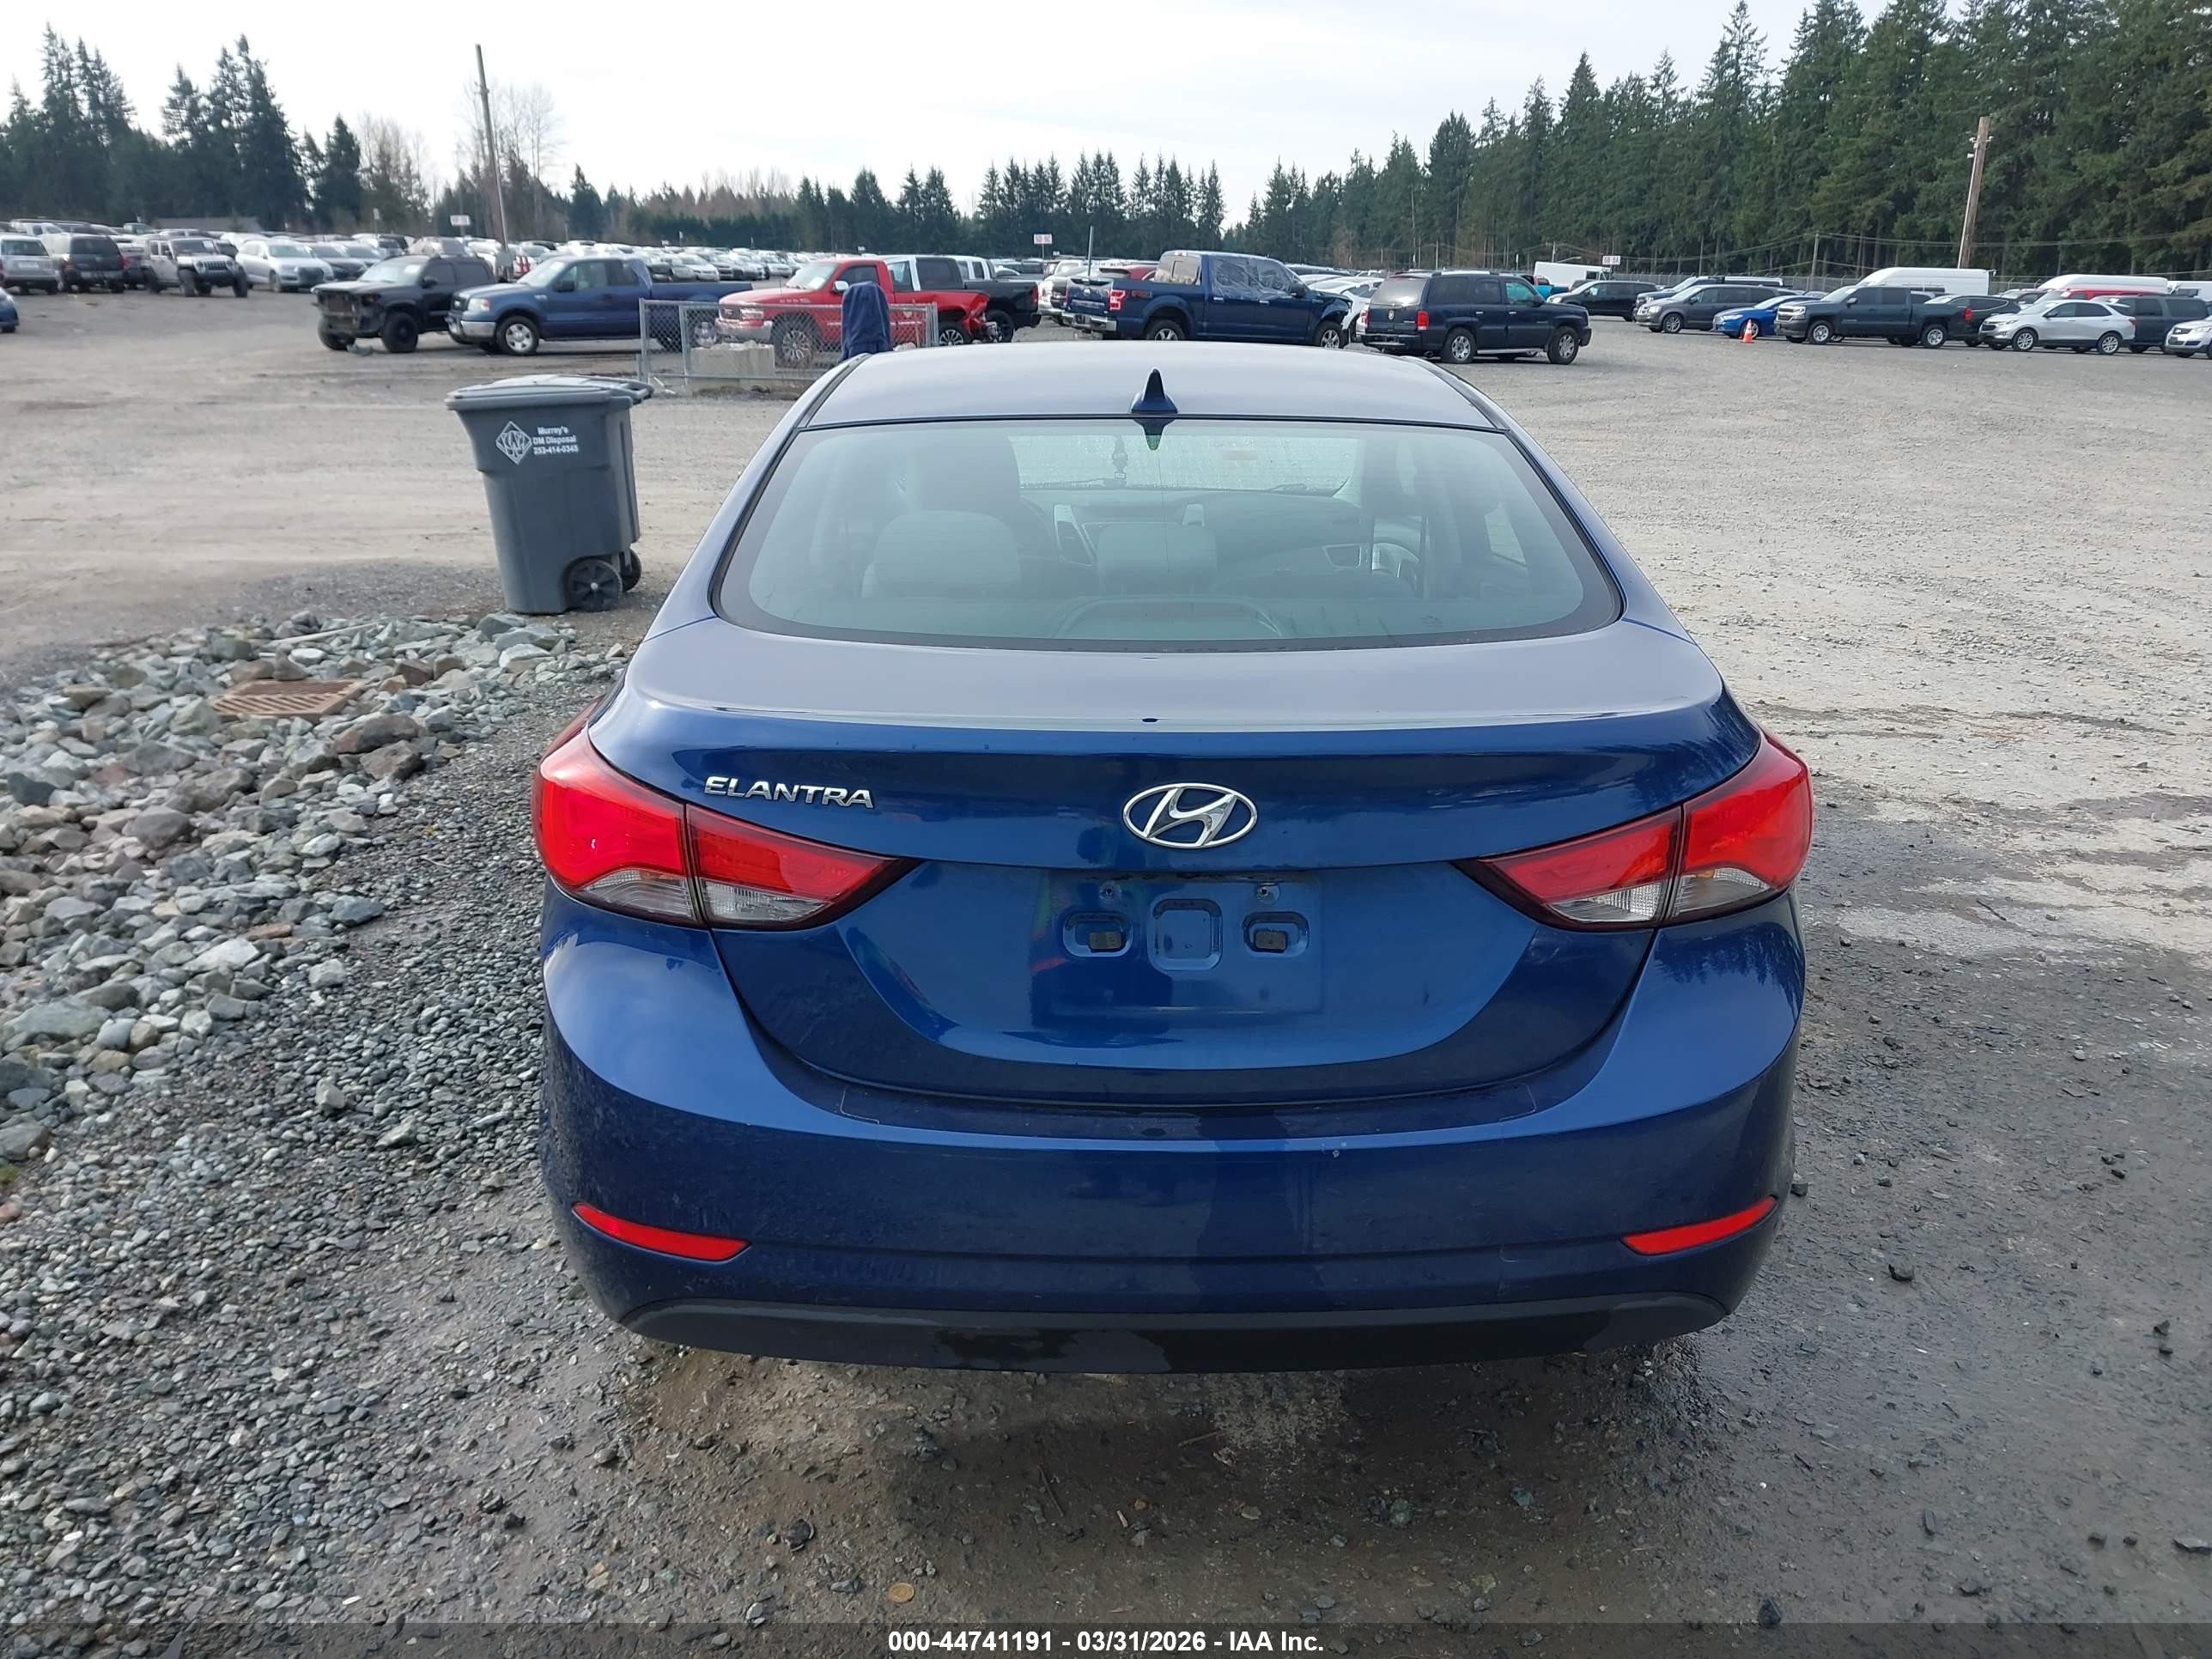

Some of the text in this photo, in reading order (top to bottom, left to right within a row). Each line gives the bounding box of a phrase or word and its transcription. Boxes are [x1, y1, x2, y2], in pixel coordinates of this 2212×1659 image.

[532, 434, 577, 445] DM Disposal
[704, 775, 874, 809] ELANTRA
